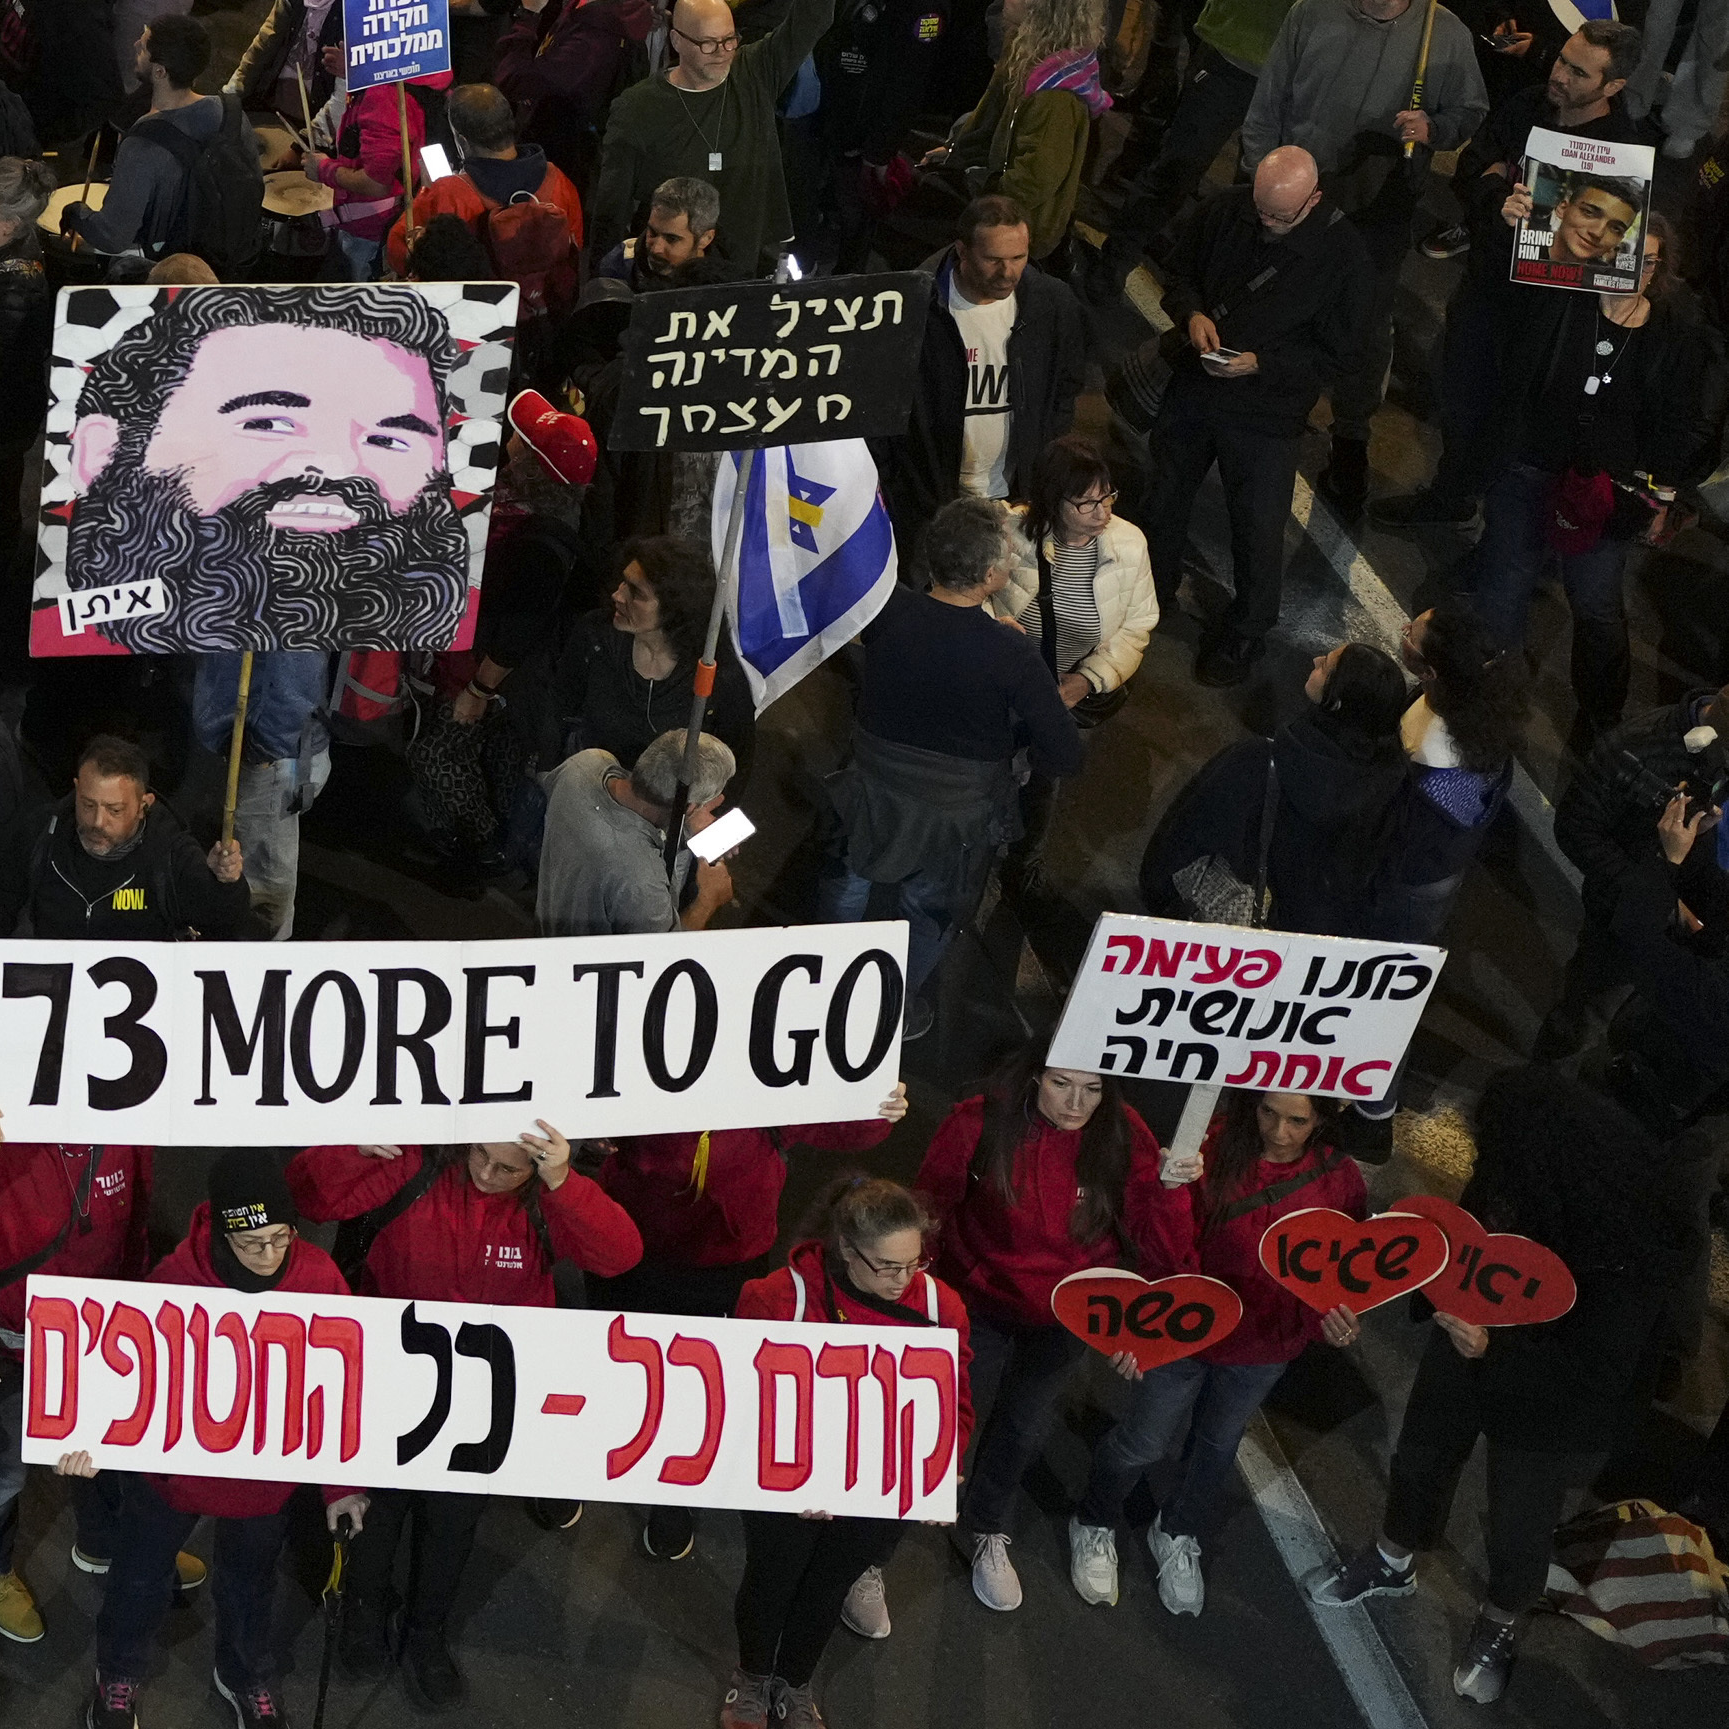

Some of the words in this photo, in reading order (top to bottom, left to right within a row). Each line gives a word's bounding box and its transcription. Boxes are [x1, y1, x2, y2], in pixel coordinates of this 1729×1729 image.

[362, 2, 430, 37] חקירה
[349, 29, 444, 68] ממלכתית
[1517, 244, 1540, 261] HIM
[1518, 229, 1554, 248] BRING
[654, 304, 739, 344] את
[769, 289, 905, 339] תציל
[646, 343, 843, 389] המדינה
[66, 586, 152, 631] איתן
[113, 888, 148, 912] NOW.
[1101, 935, 1284, 989] פעימה
[1299, 953, 1436, 1002] כולנו
[2, 956, 169, 1110] 73
[194, 964, 536, 1107] MORE
[572, 957, 720, 1100] TO
[748, 946, 907, 1089] GO
[1115, 986, 1354, 1047] אנושית
[1099, 1034, 1220, 1084] חיה
[1276, 1232, 1419, 1296] שגיא
[1086, 1290, 1215, 1344] סשה
[26, 1294, 365, 1464] החטופים
[396, 1302, 517, 1474] כל
[606, 1314, 727, 1486] כל
[755, 1340, 959, 1519] קודם
